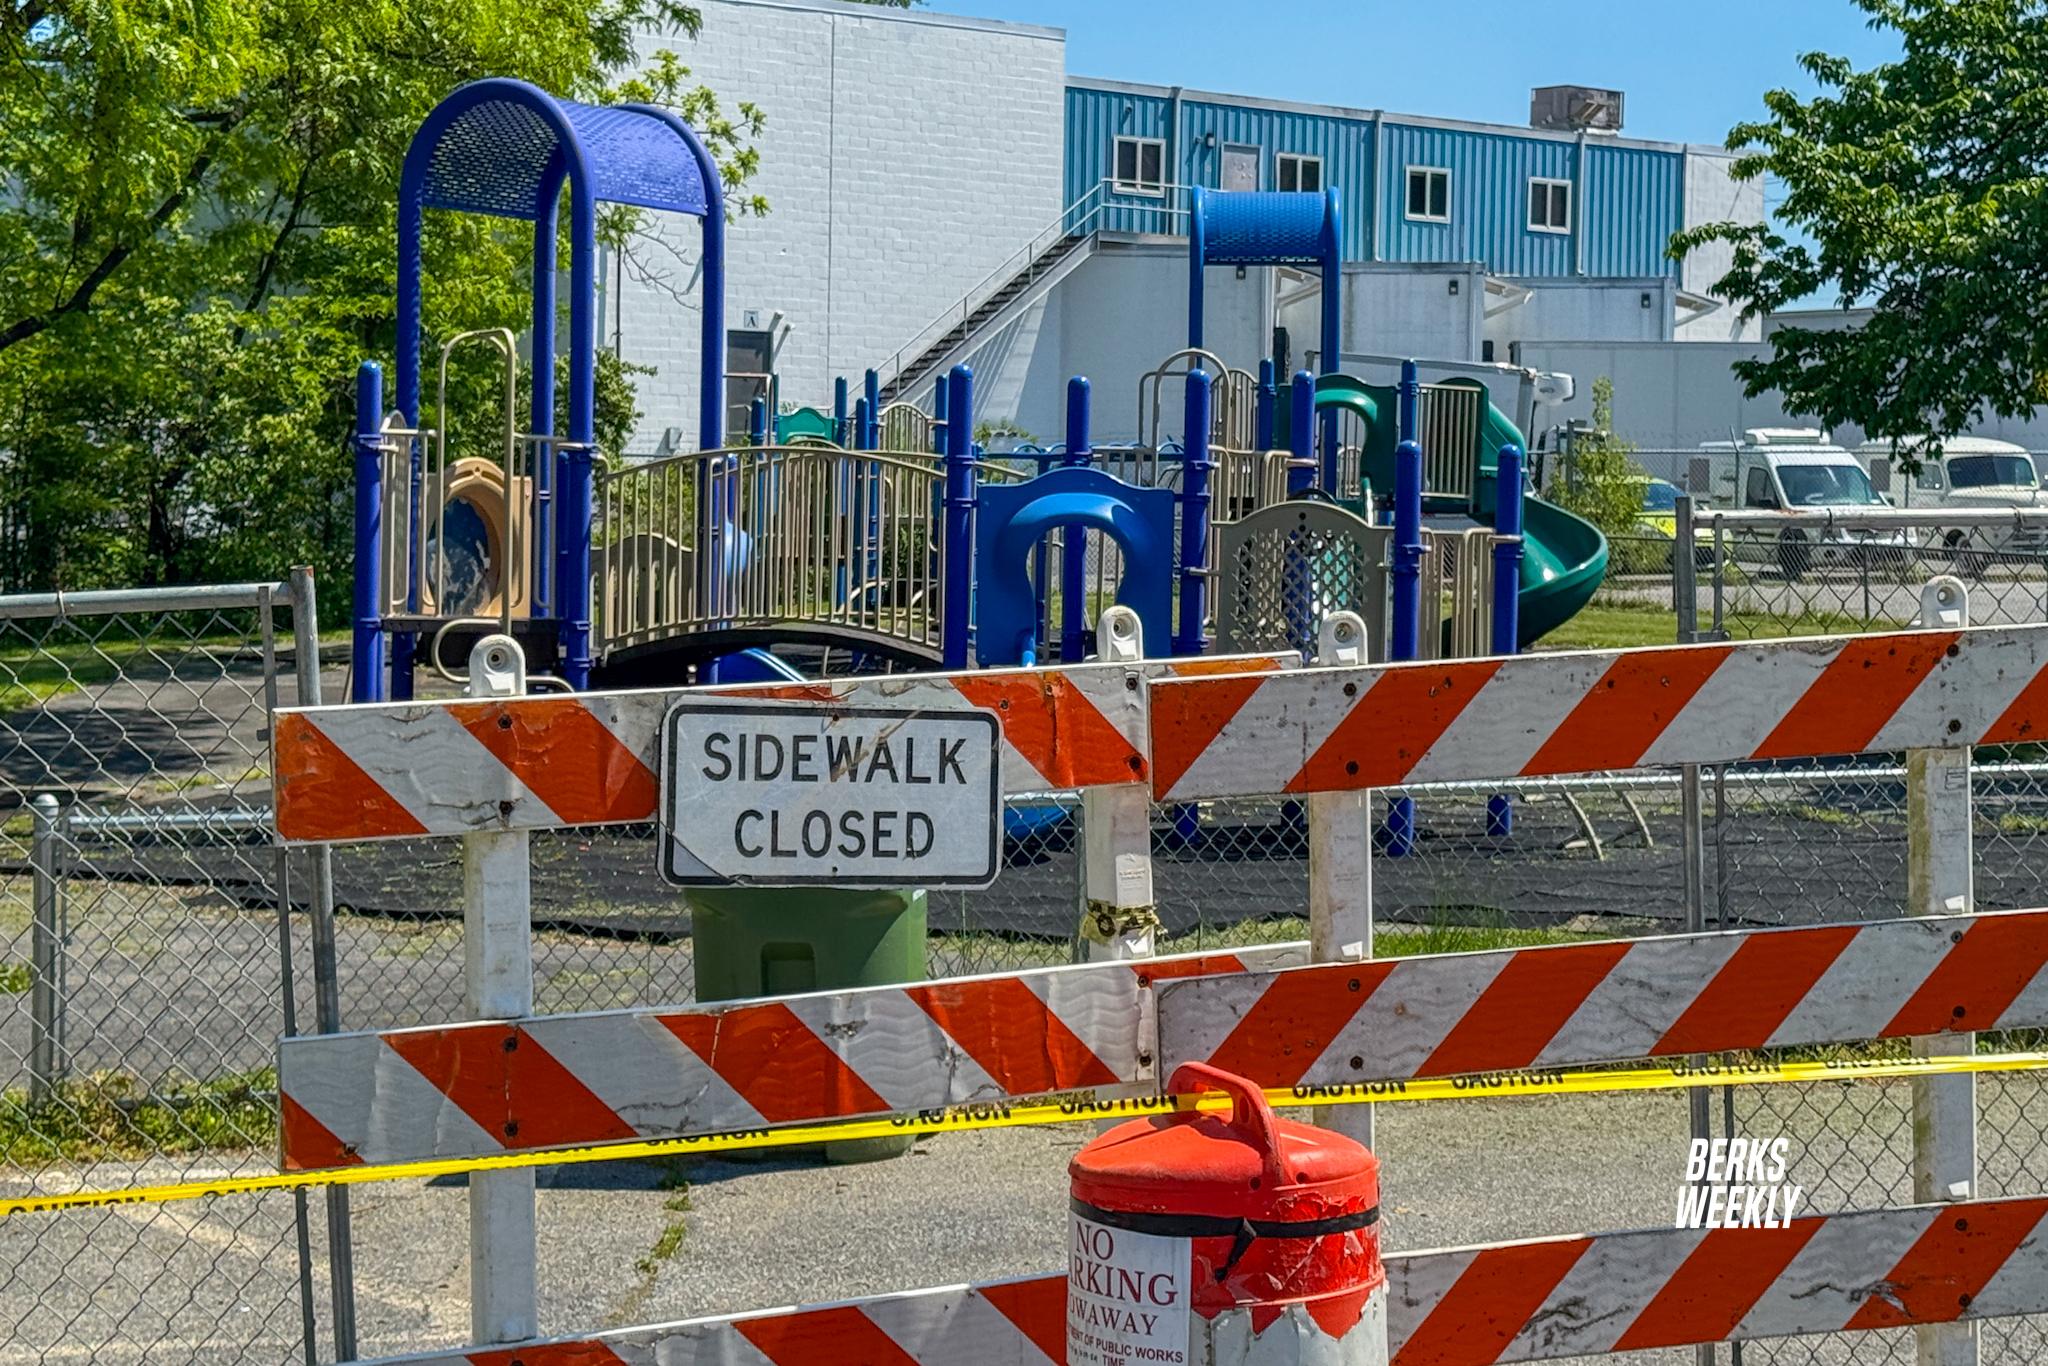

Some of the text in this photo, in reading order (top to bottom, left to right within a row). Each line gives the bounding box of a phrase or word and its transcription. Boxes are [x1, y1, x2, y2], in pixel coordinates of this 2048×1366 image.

[702, 732, 967, 784] SIDEWALK
[734, 809, 935, 860] CLOSED
[1076, 1220, 1115, 1261] NO
[1070, 1256, 1178, 1307] RKING
[1096, 1337, 1132, 1357] PUBLIC
[1135, 1346, 1184, 1364] WORKS
